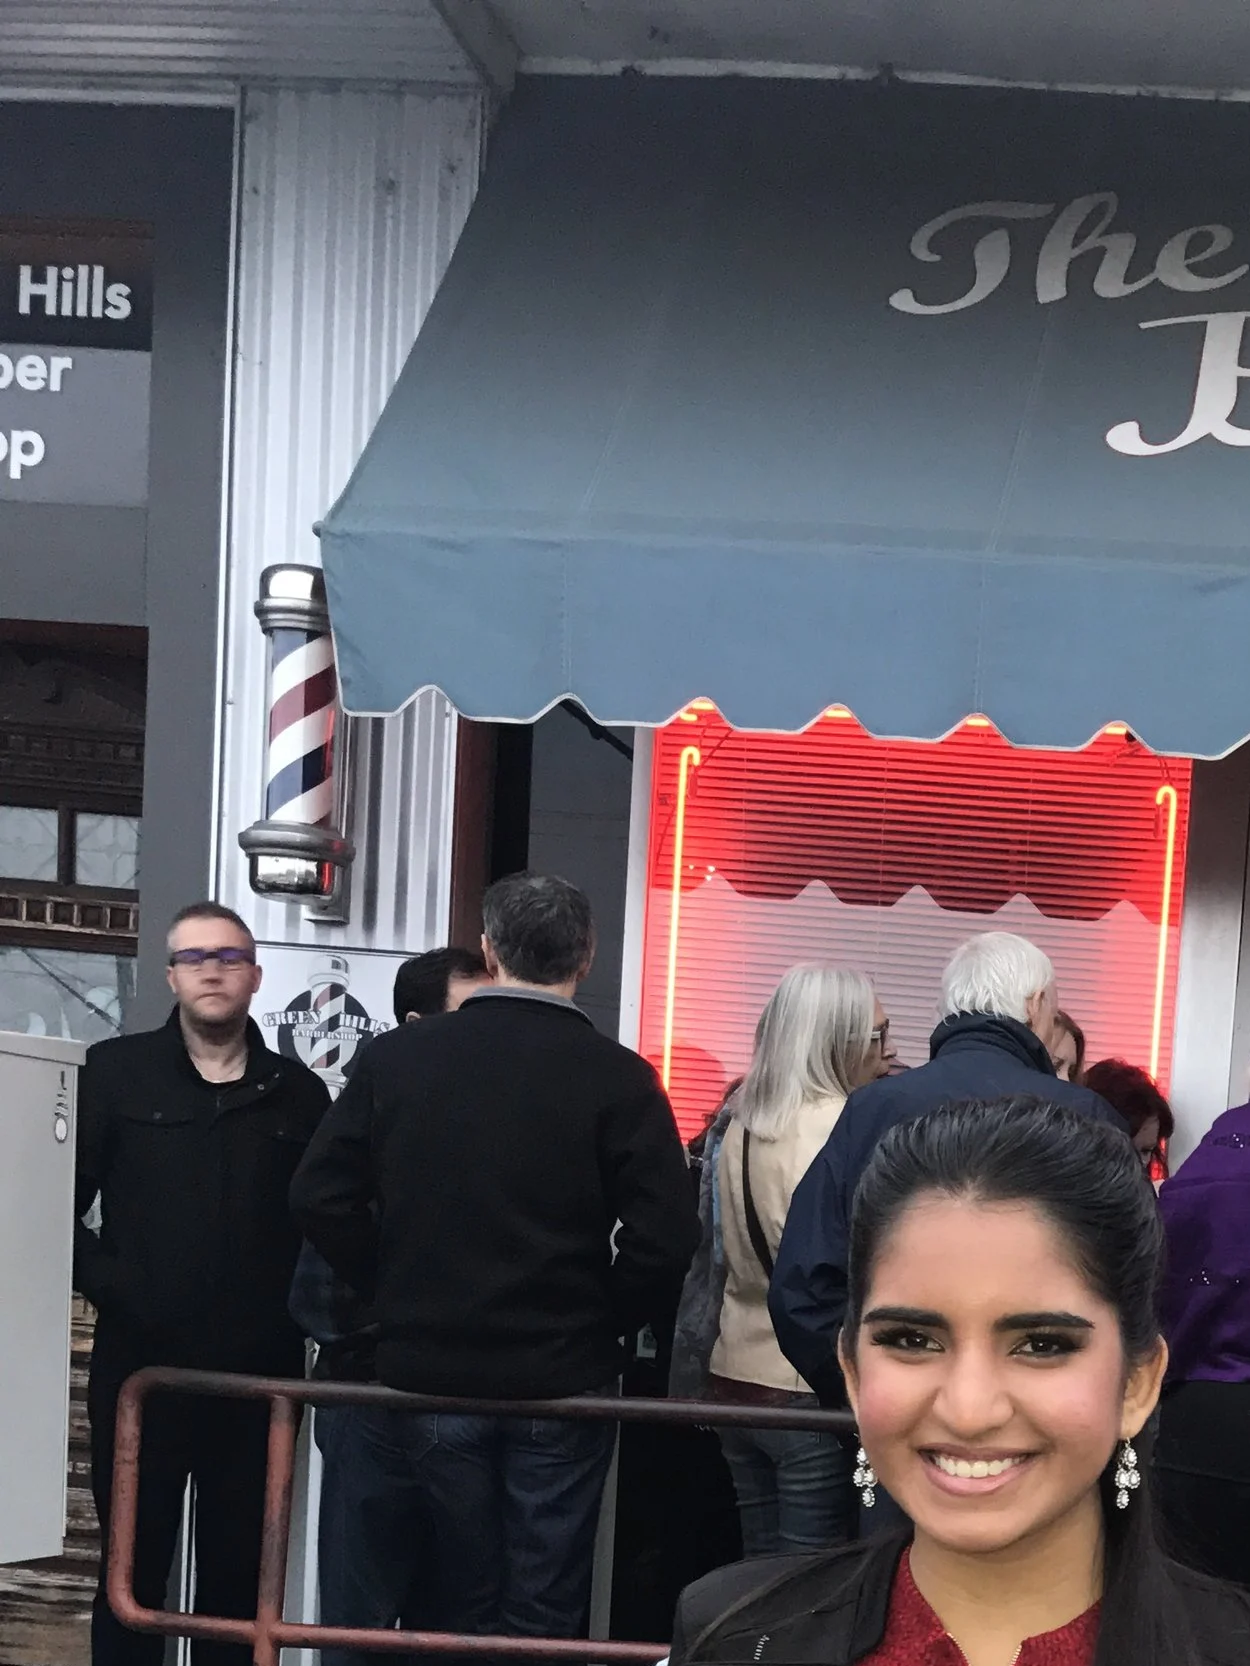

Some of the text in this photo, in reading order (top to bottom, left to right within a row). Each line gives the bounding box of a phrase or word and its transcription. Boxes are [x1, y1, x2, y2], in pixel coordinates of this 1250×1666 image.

[888, 191, 1250, 315] The
[18, 264, 132, 320] Hills
[0, 429, 45, 480] p
[262, 1008, 322, 1027] GREEN
